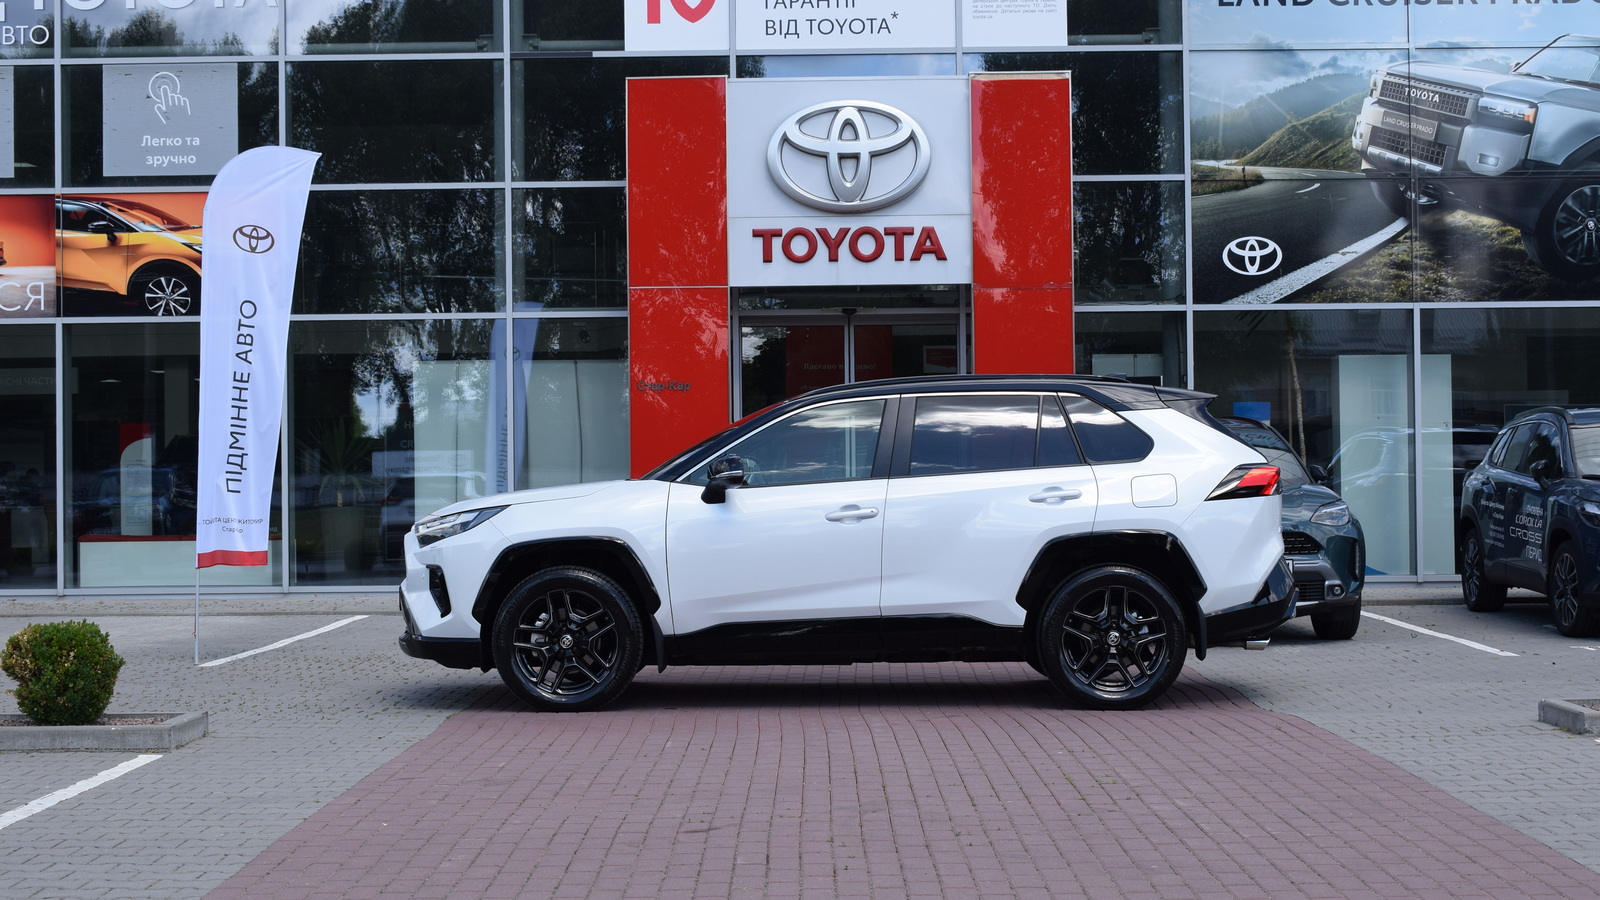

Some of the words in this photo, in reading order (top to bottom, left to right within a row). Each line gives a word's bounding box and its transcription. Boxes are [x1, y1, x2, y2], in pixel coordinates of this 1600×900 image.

[765, 19, 800, 39] ВІД
[1404, 87, 1439, 102] TOYOTA
[141, 135, 182, 146] Легко
[185, 137, 200, 146] та
[145, 155, 197, 167] зручно
[752, 226, 947, 263] TOYOTA
[235, 299, 257, 365] АВТО
[637, 380, 691, 392] Стар-Кар
[225, 371, 250, 494] ПІДМІННЕ
[202, 517, 222, 526] ТОЙТА
[1515, 514, 1543, 528] COROLLA
[1509, 526, 1542, 544] CROSS
